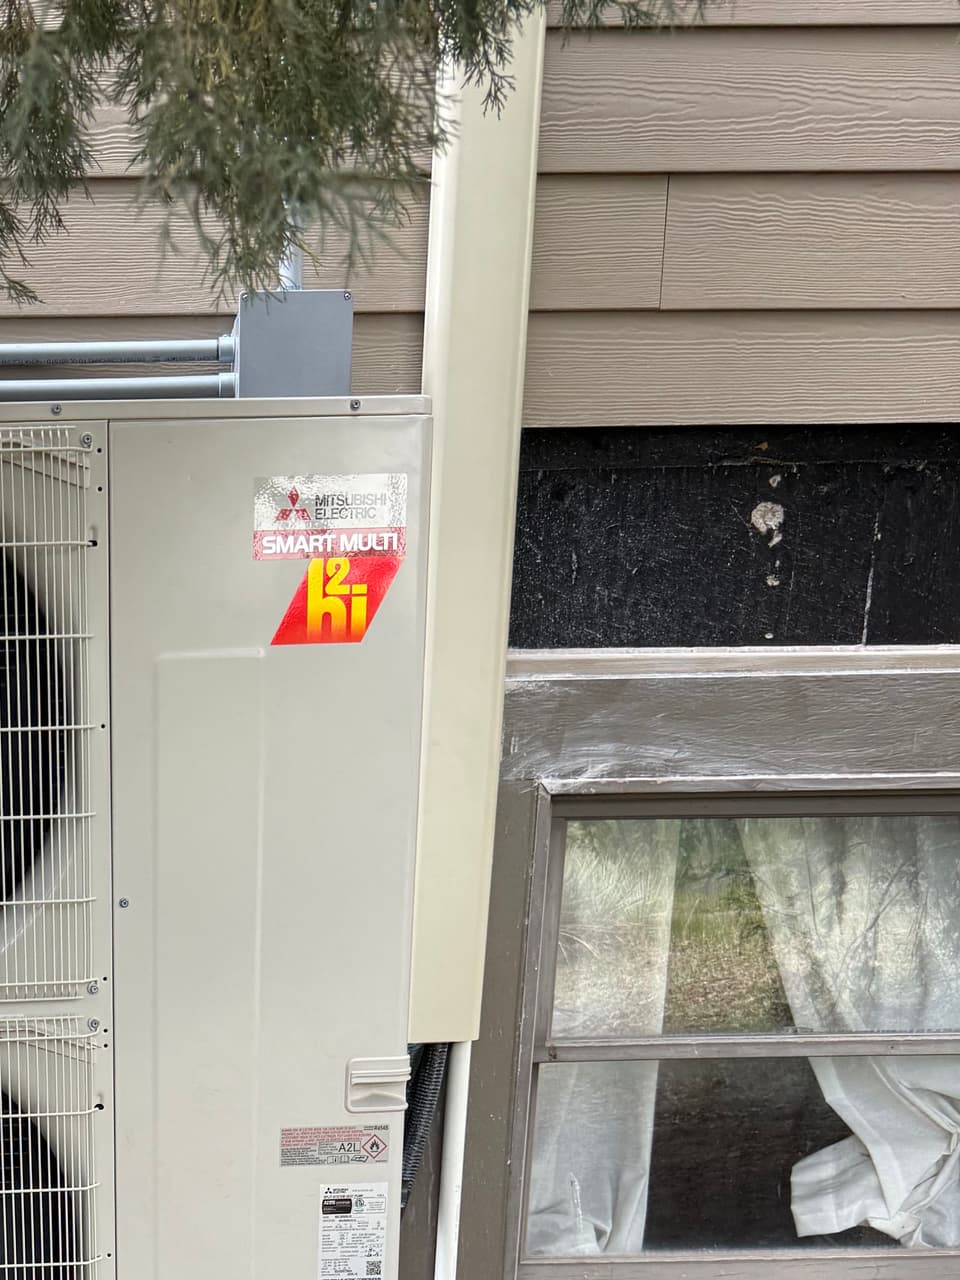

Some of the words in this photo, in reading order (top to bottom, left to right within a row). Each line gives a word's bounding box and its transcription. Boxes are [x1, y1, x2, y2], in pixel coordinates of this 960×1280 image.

[314, 493, 387, 507] MITSUBISHI
[314, 507, 377, 521] ELECTRIC
[261, 534, 337, 554] SMART
[339, 532, 398, 552] MULTI
[338, 1142, 360, 1153] A2L
